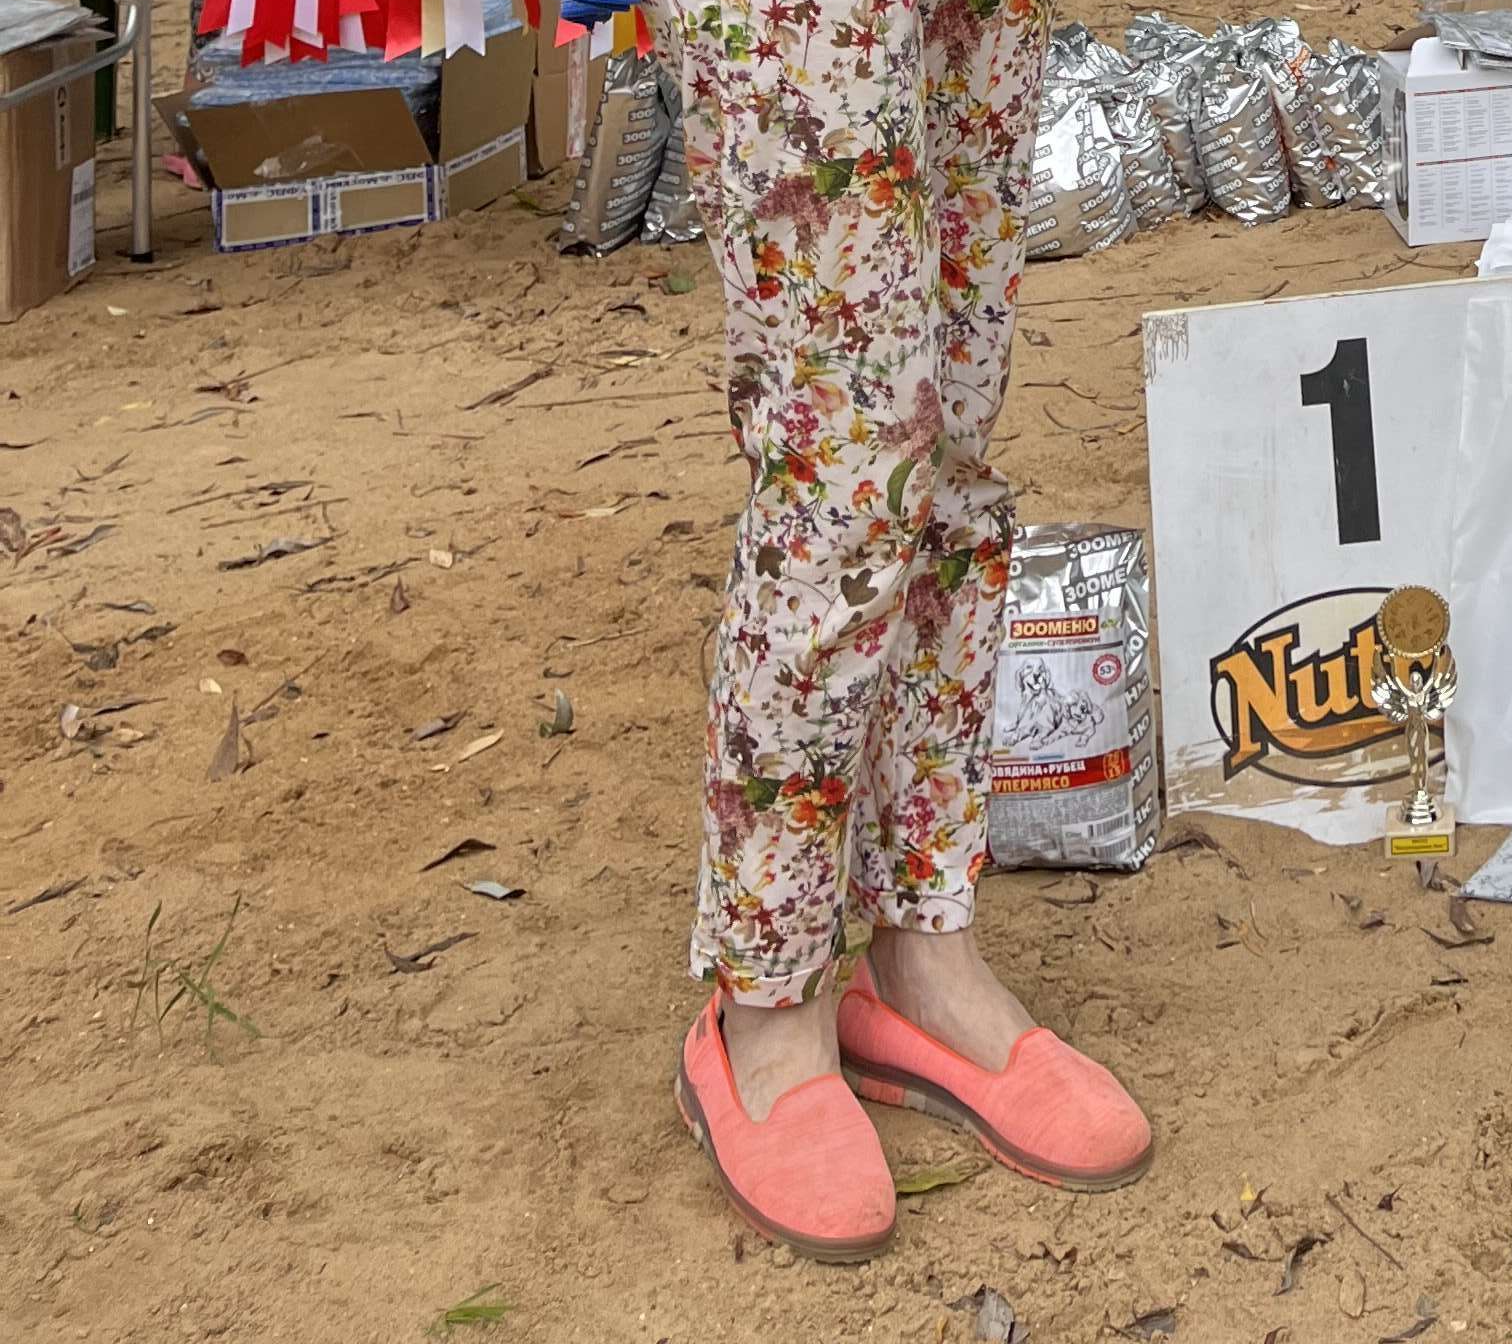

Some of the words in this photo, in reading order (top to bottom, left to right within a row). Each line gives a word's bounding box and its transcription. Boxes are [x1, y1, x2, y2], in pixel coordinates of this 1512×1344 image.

[1300, 337, 1381, 545] 1
[1012, 618, 1097, 637] ЗООМЕНЮ
[991, 775, 1070, 793] УПЕРМЯСО
